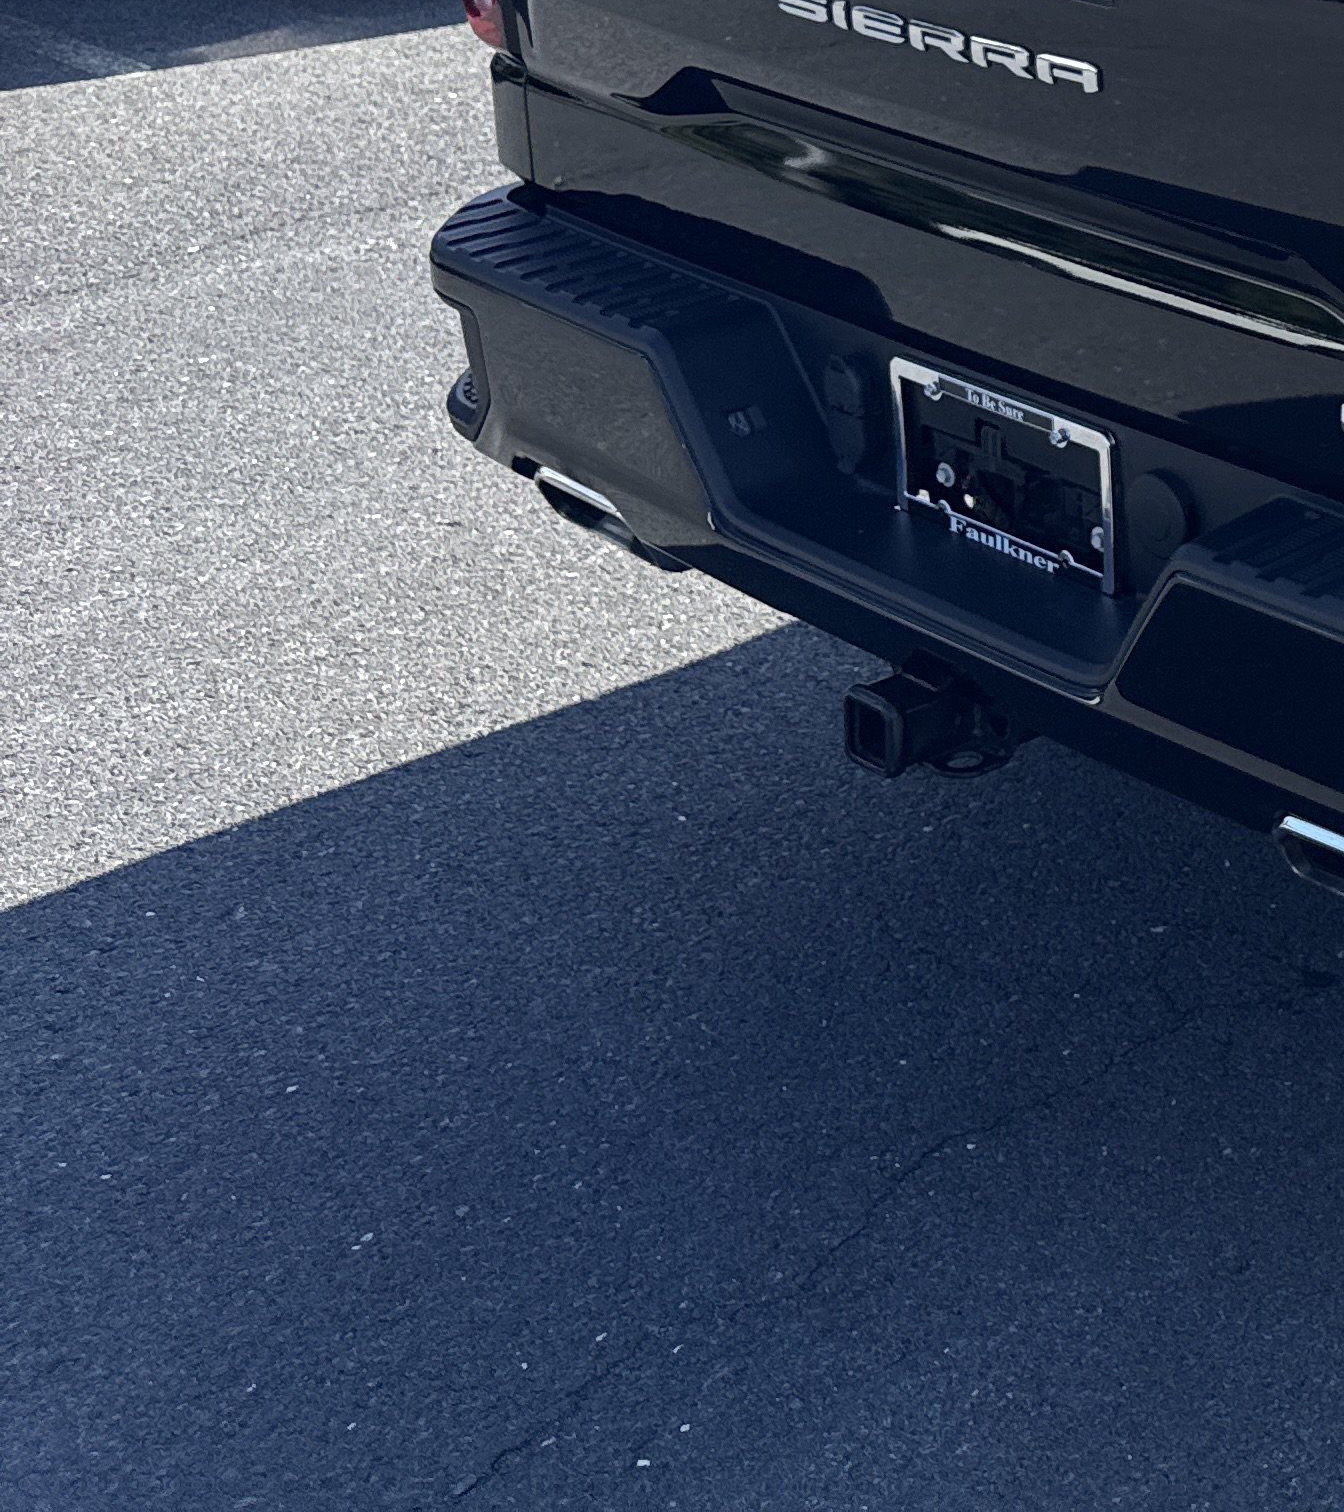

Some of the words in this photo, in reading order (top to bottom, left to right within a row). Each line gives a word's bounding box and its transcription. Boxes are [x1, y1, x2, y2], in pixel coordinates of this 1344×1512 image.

[965, 388, 980, 404] To
[982, 393, 996, 413] Be
[998, 399, 1024, 422] Sure
[950, 515, 1060, 574] Faulkner
